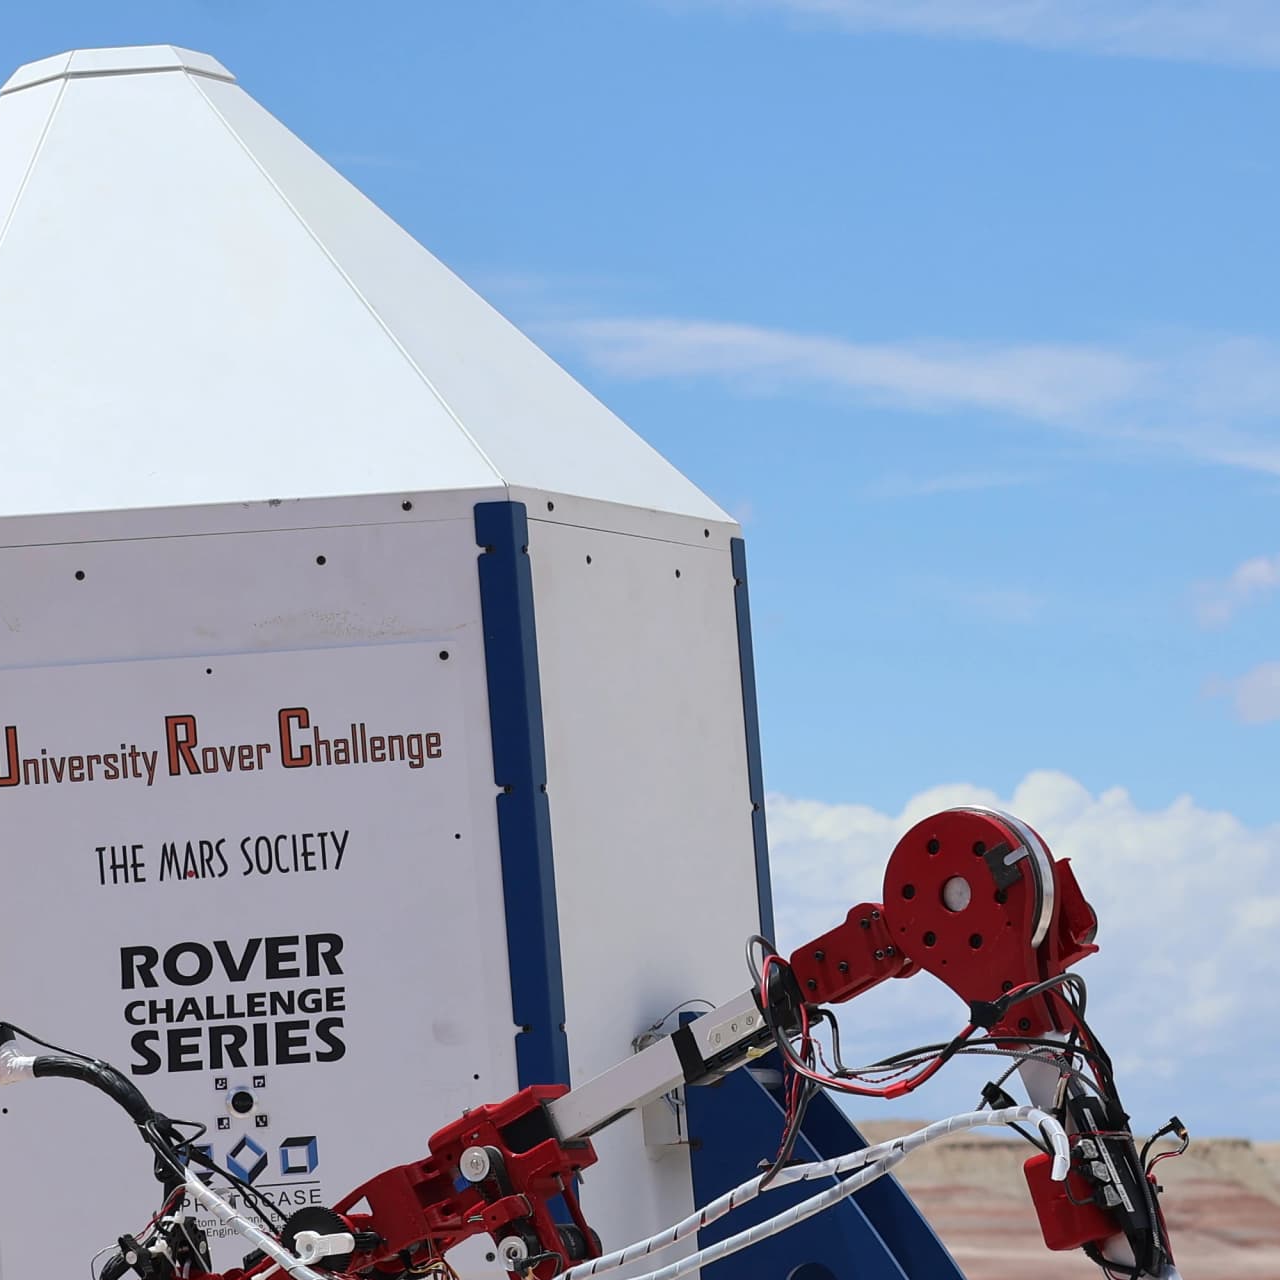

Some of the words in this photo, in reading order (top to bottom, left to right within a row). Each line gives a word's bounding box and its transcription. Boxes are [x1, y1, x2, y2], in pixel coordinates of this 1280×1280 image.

[164, 714, 271, 776] Rover
[278, 707, 442, 769] Challenge
[95, 843, 146, 885] THE
[159, 837, 229, 882] MARS
[240, 830, 349, 876] SOCIETY
[120, 932, 344, 990] ROVER
[124, 986, 346, 1026] CHALLENGE
[130, 1017, 347, 1075] SERIES
[181, 1188, 323, 1214] PRTOCASE
